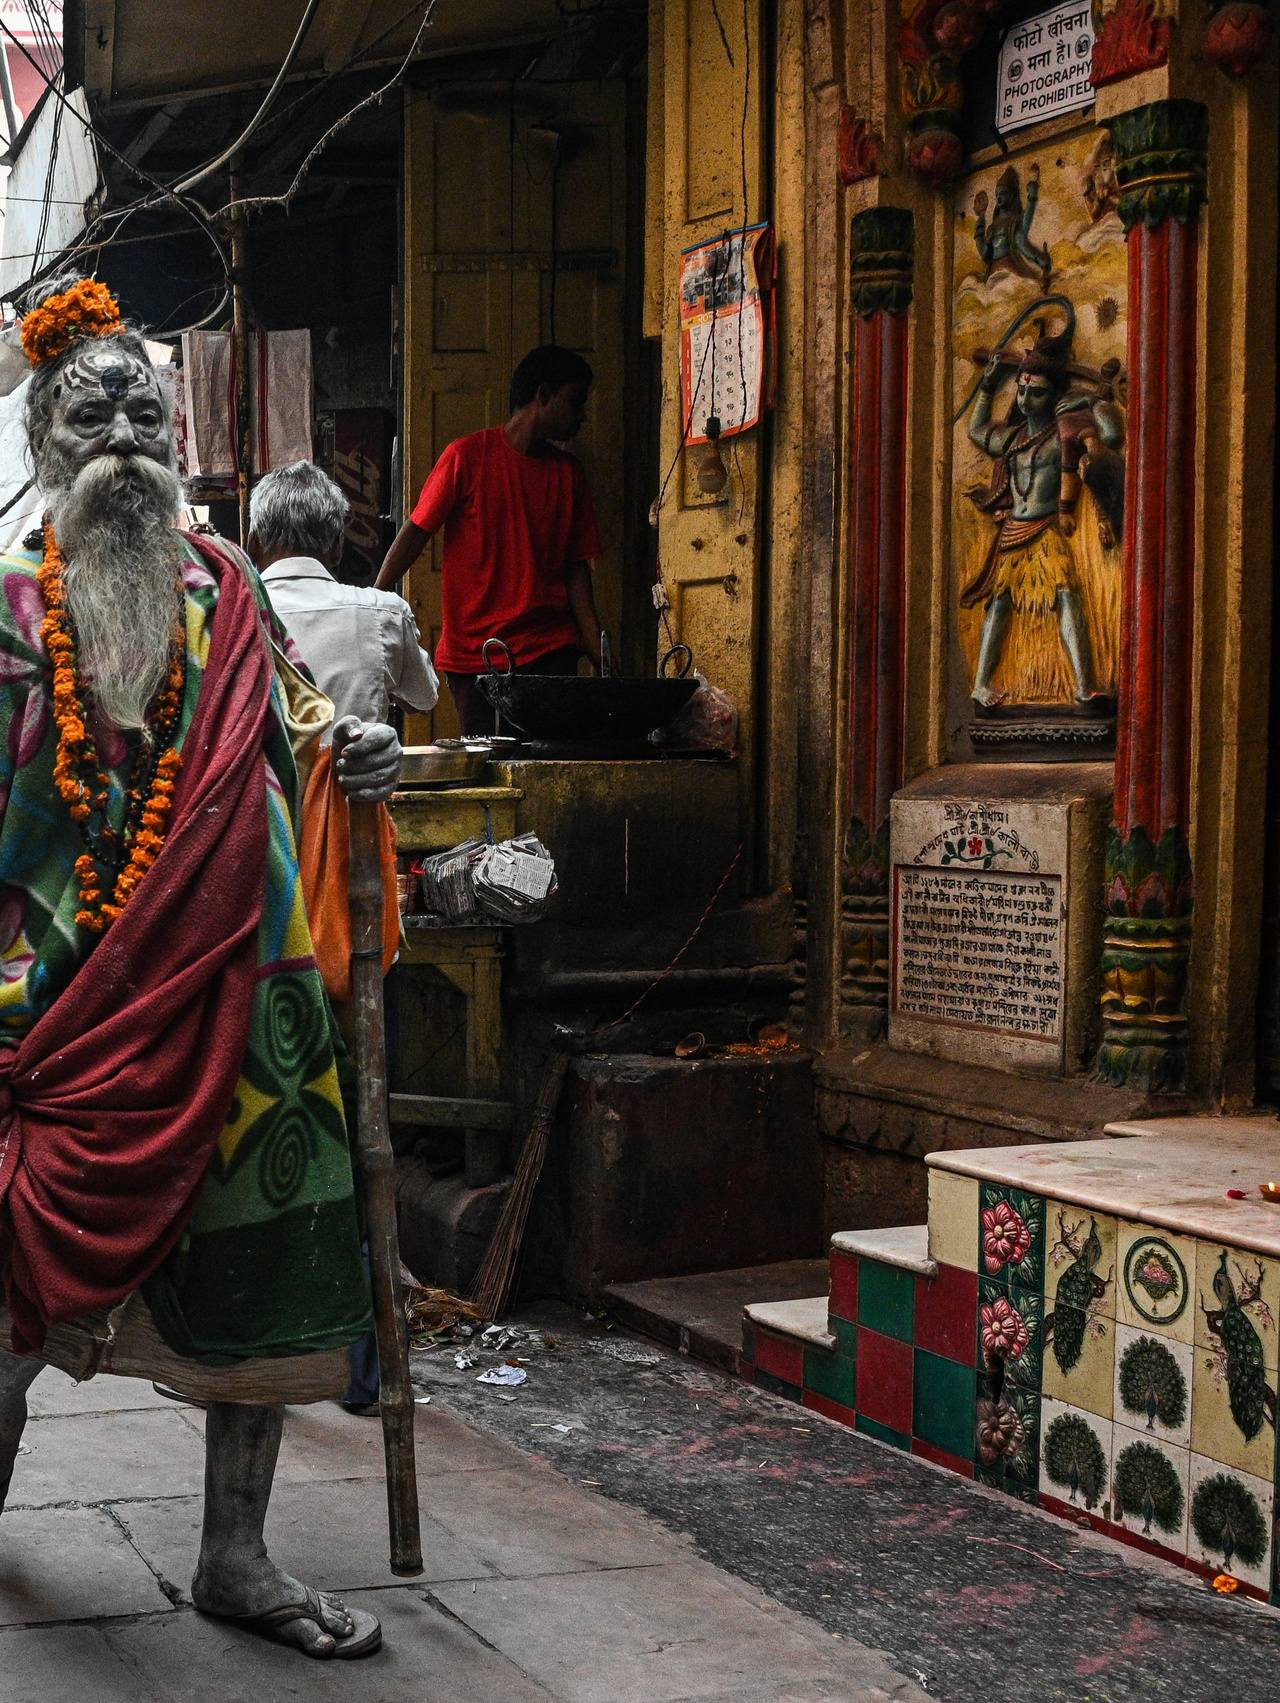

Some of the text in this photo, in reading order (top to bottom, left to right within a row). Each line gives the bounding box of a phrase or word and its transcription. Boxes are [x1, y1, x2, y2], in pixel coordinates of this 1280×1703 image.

[1013, 9, 1089, 52] फोटो खींचना
[1004, 59, 1092, 100] PHOTOGRAPHY
[1027, 49, 1052, 72] मना
[1003, 80, 1093, 119] IS PROHIBITED
